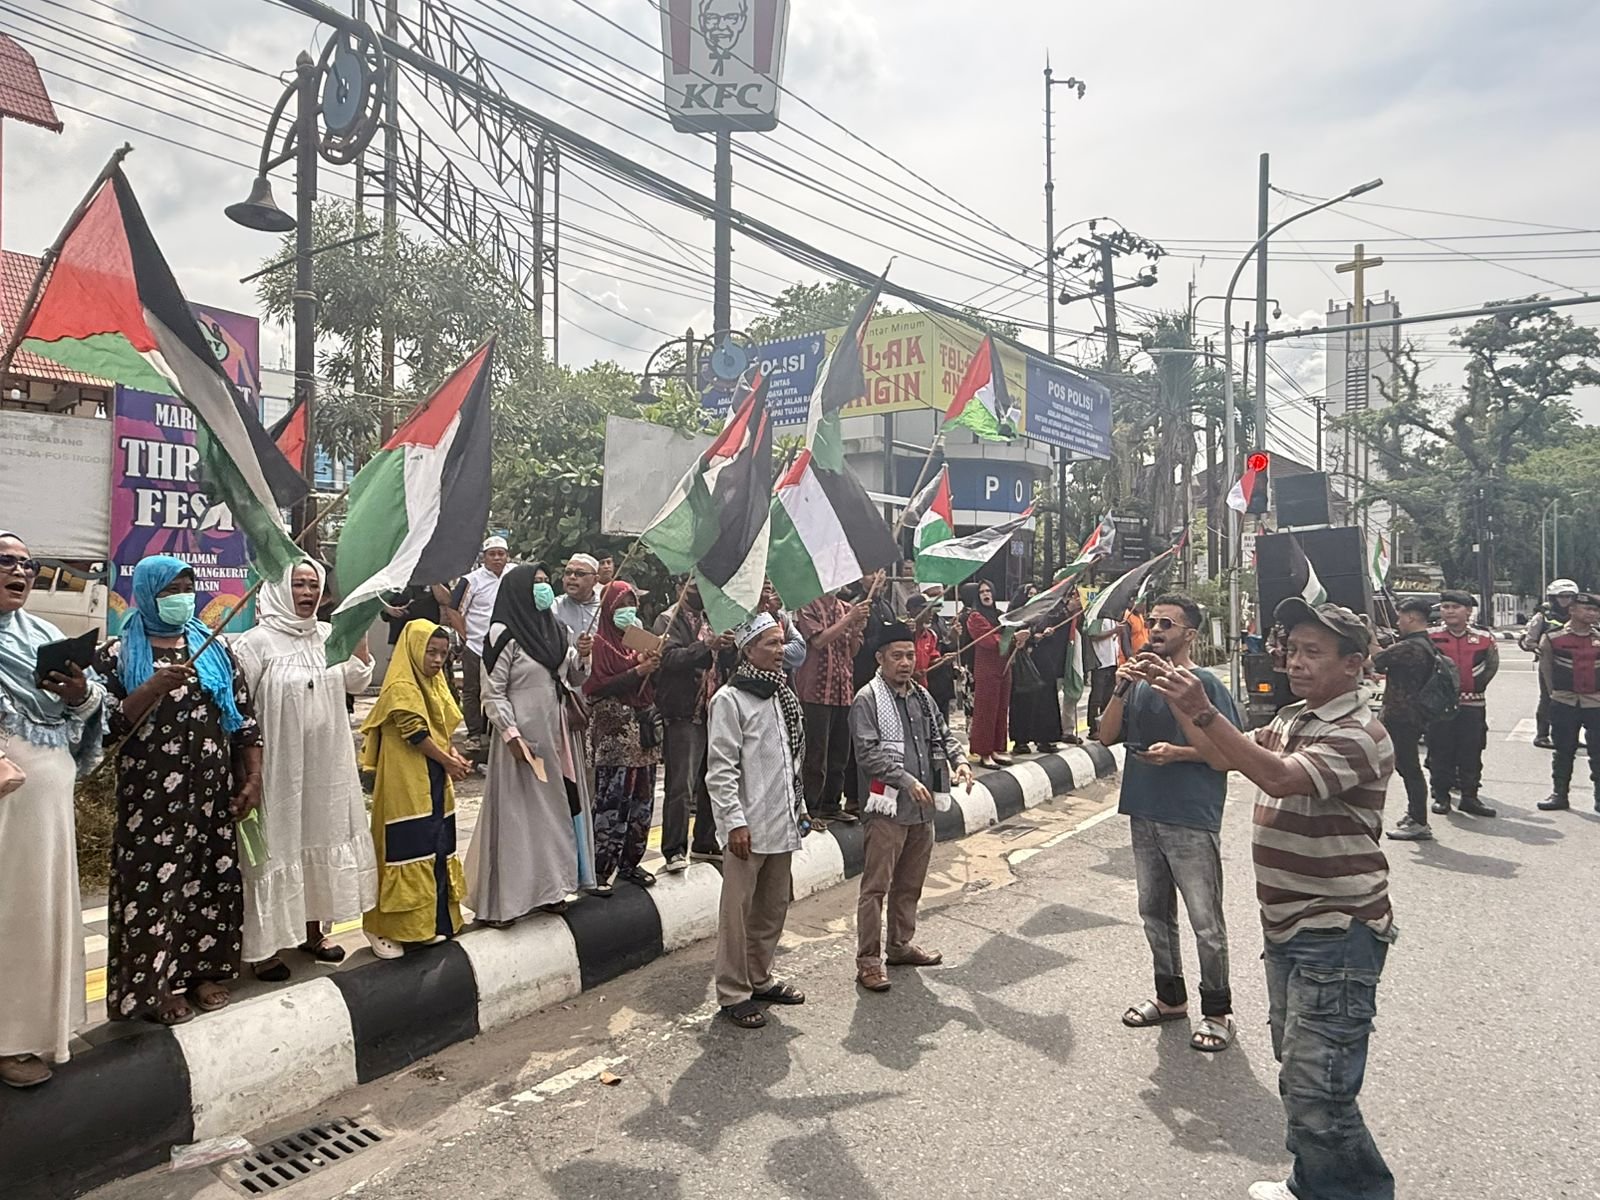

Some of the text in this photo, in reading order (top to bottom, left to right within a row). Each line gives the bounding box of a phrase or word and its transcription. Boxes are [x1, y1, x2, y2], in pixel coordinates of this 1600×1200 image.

[680, 83, 763, 109] KFC
[865, 320, 926, 337] intar Minum
[750, 354, 805, 377] OLISI
[866, 335, 926, 371] LAK
[1048, 380, 1066, 401] POS
[1067, 388, 1093, 412] POLISI
[121, 437, 200, 482] THR
